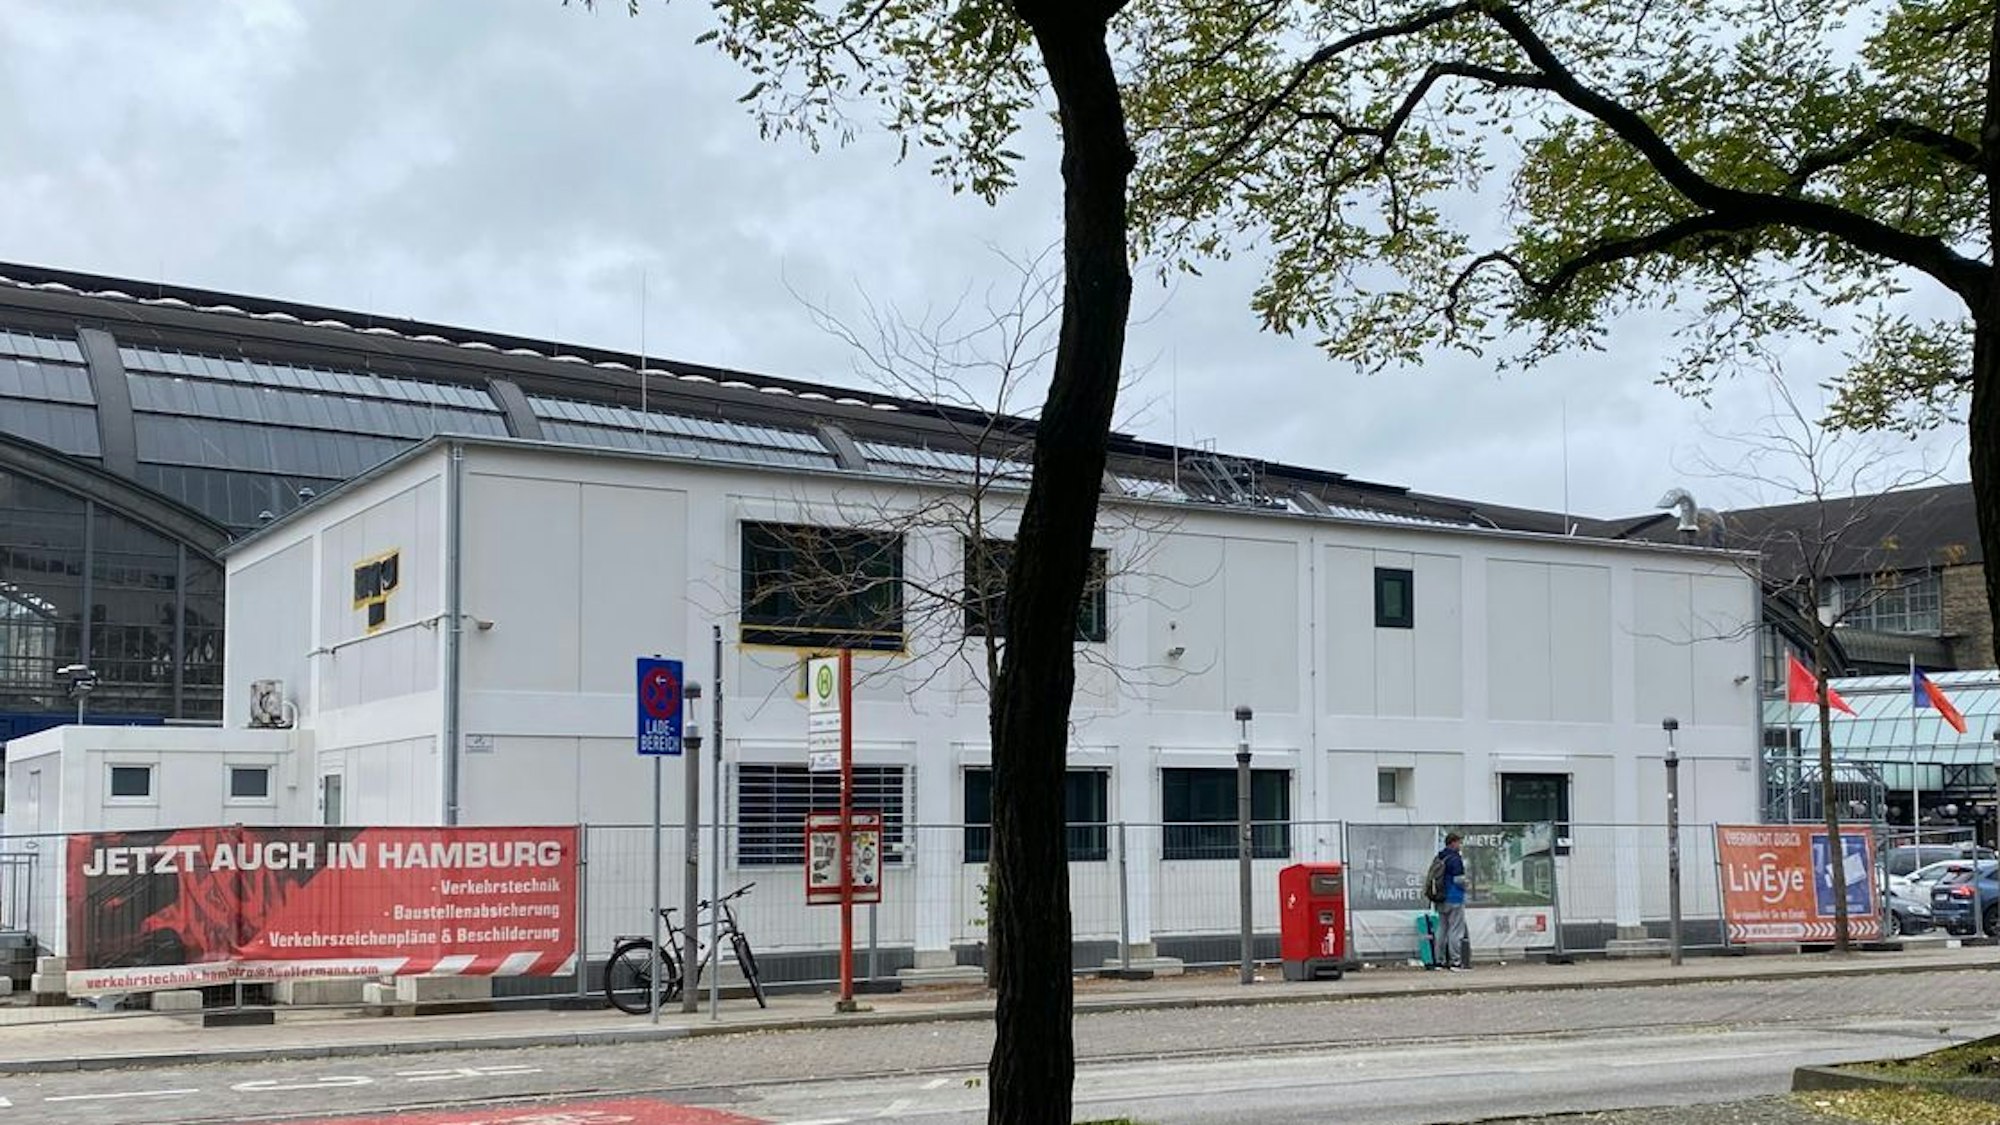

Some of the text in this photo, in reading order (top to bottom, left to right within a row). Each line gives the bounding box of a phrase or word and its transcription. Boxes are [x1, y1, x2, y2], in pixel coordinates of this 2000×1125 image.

[645, 719, 675, 735] LADE-
[640, 734, 680, 752] BEREICH
[83, 841, 561, 877] JETZT AUCH IN HAMBURG
[440, 879, 560, 896] Verkehrstechnik
[1728, 862, 1805, 904] LivEye
[1375, 887, 1423, 901] WARTET
[394, 904, 559, 920] Baustellenabsicherung
[269, 926, 559, 948] Verkehrszeichenpläne & Beschilderung
